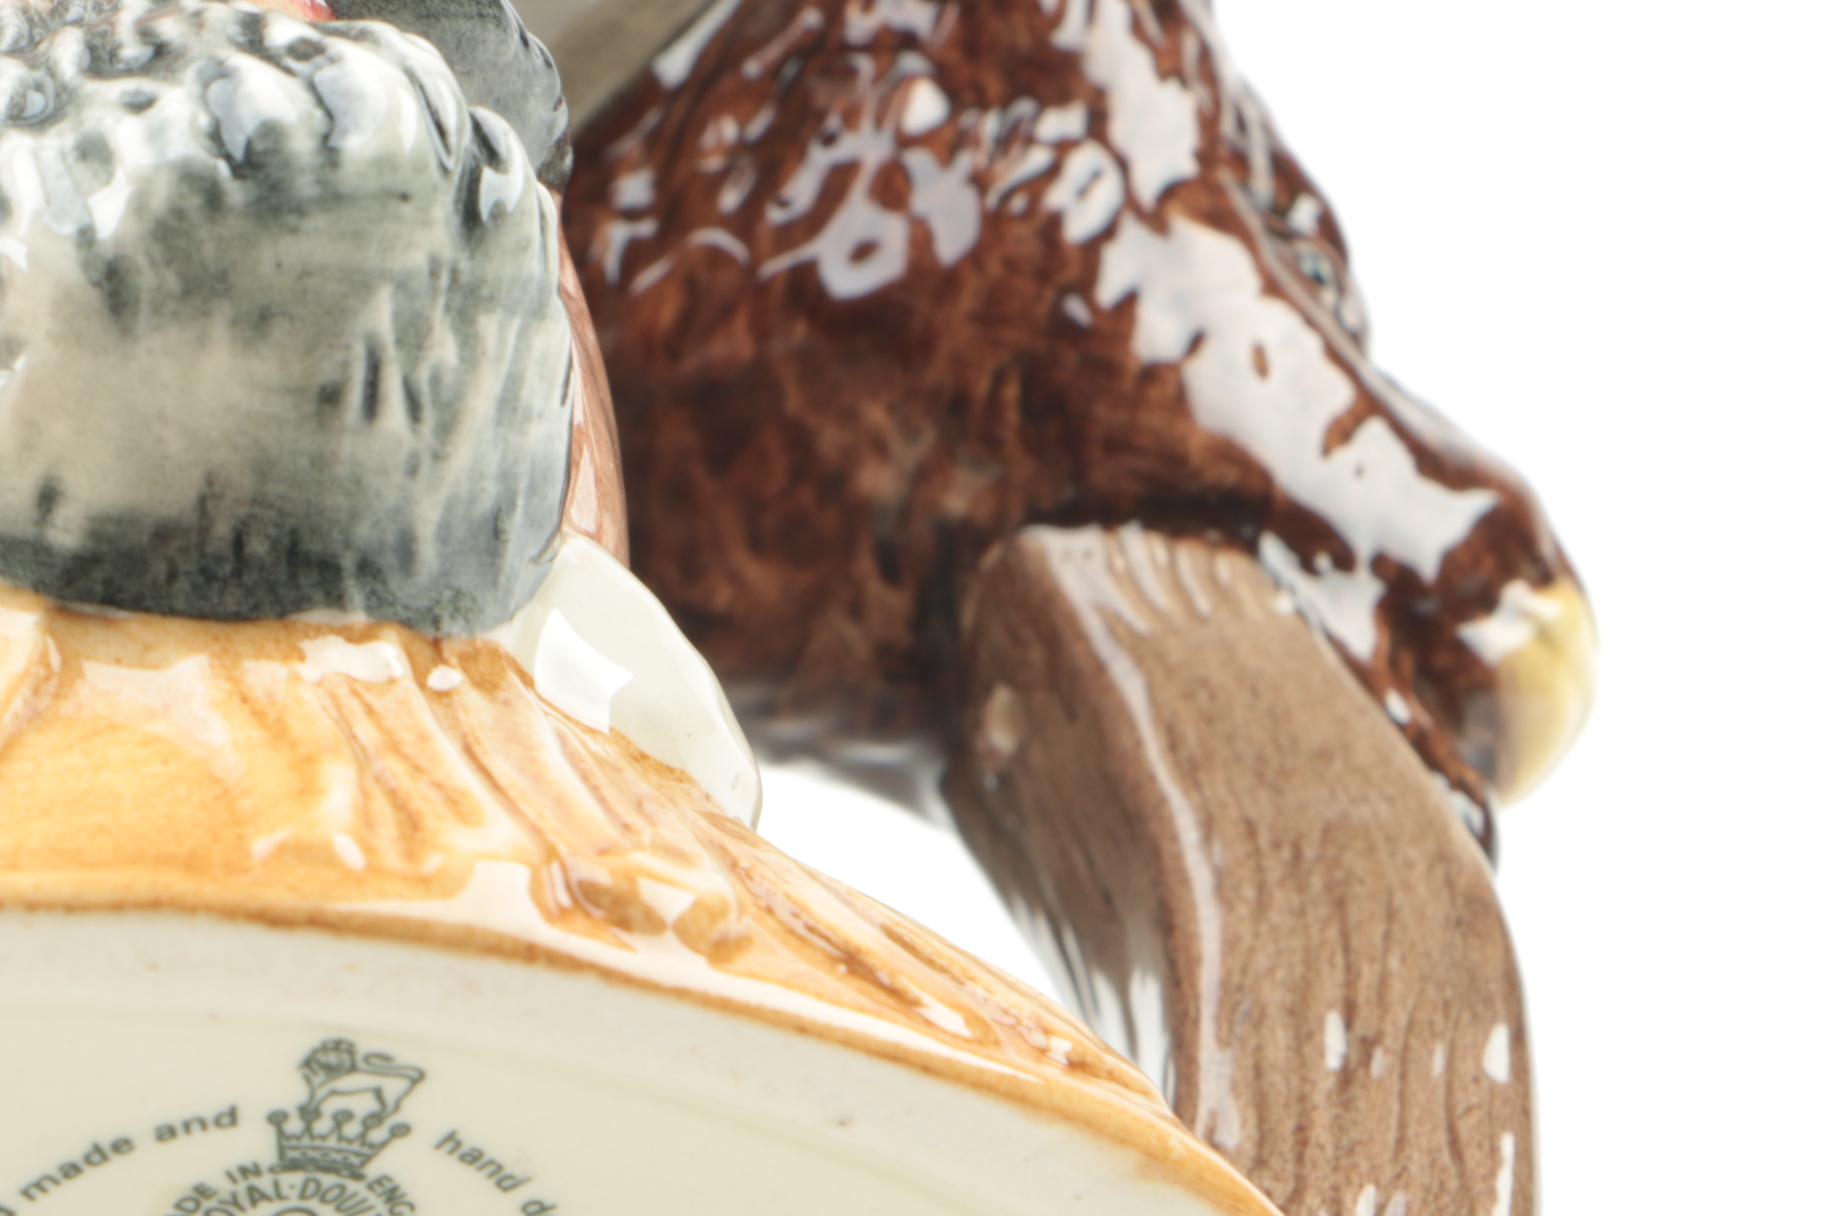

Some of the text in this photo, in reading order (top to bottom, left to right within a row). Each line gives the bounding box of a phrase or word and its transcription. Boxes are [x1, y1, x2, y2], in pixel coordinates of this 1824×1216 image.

[20, 1137, 135, 1201] made
[154, 1105, 239, 1142] and
[434, 1130, 530, 1193] hand
[225, 1162, 263, 1184] IN
